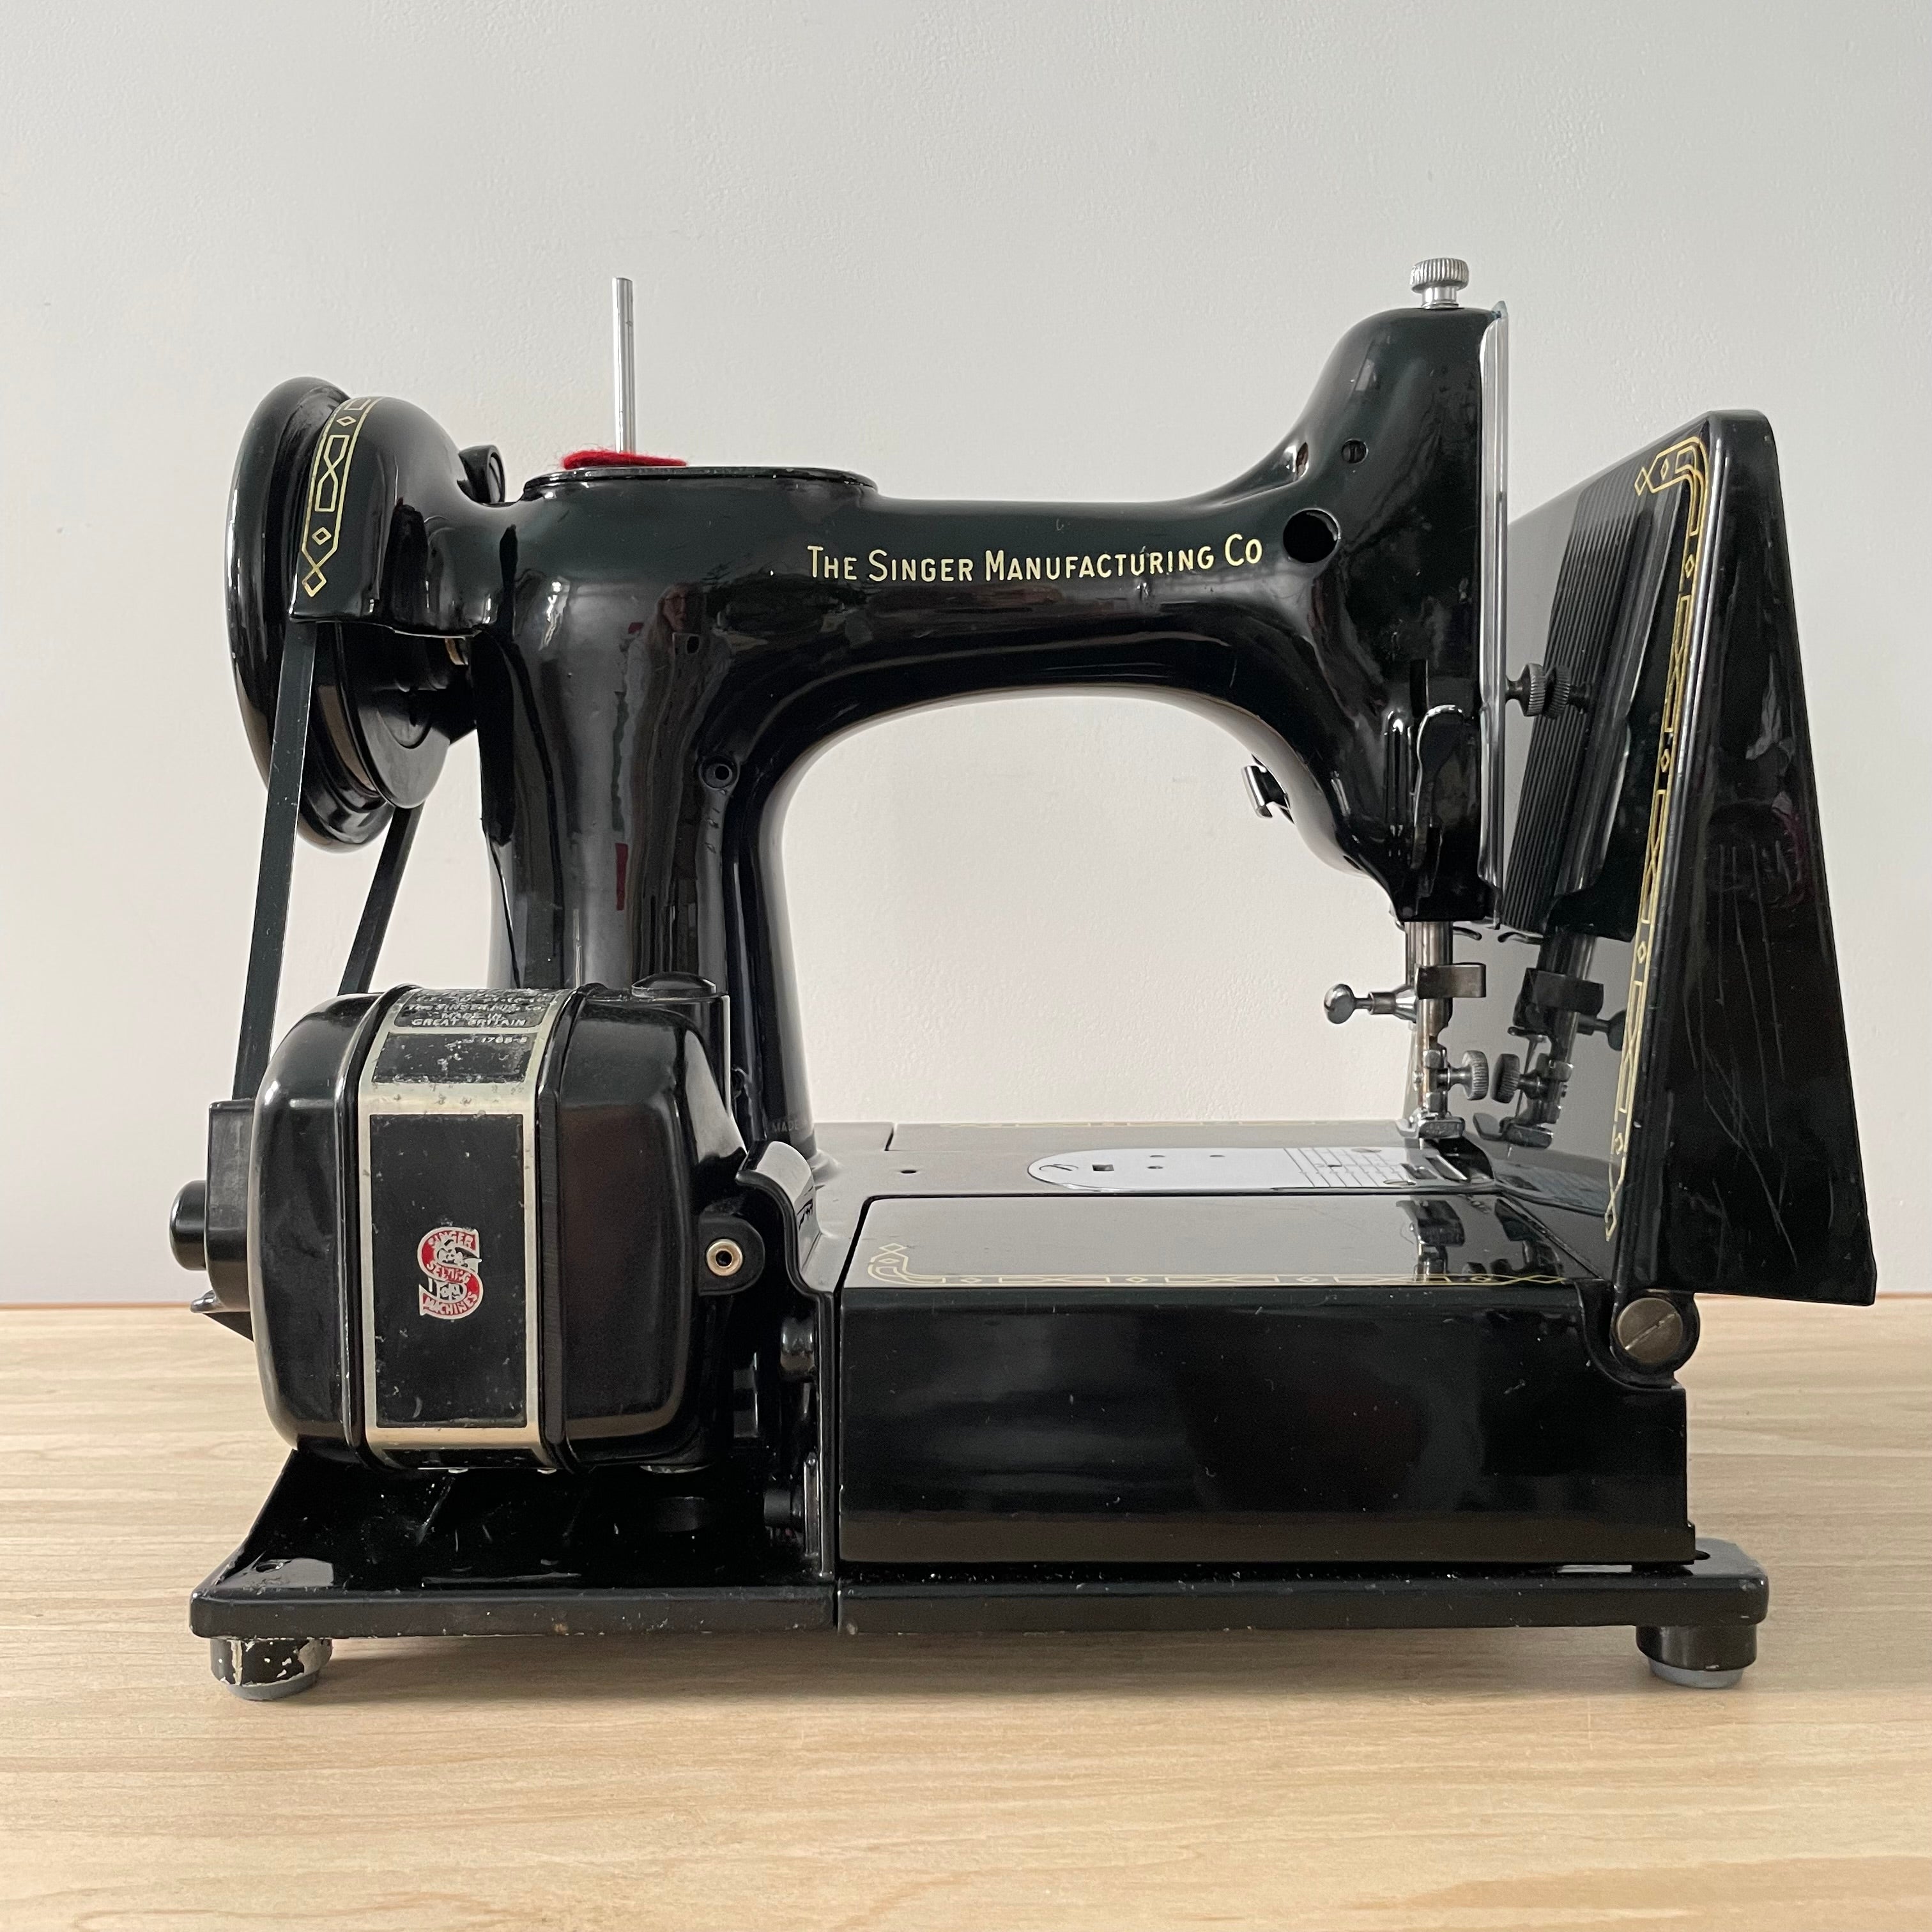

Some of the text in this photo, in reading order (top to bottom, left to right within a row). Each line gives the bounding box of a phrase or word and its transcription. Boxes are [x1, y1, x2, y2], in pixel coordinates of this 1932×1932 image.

[807, 545, 857, 580] THE
[868, 549, 974, 582] SINGER
[985, 546, 1214, 582] MANUFACTURING
[428, 1230, 475, 1250] SINGER
[423, 1291, 478, 1315] MACHINES
